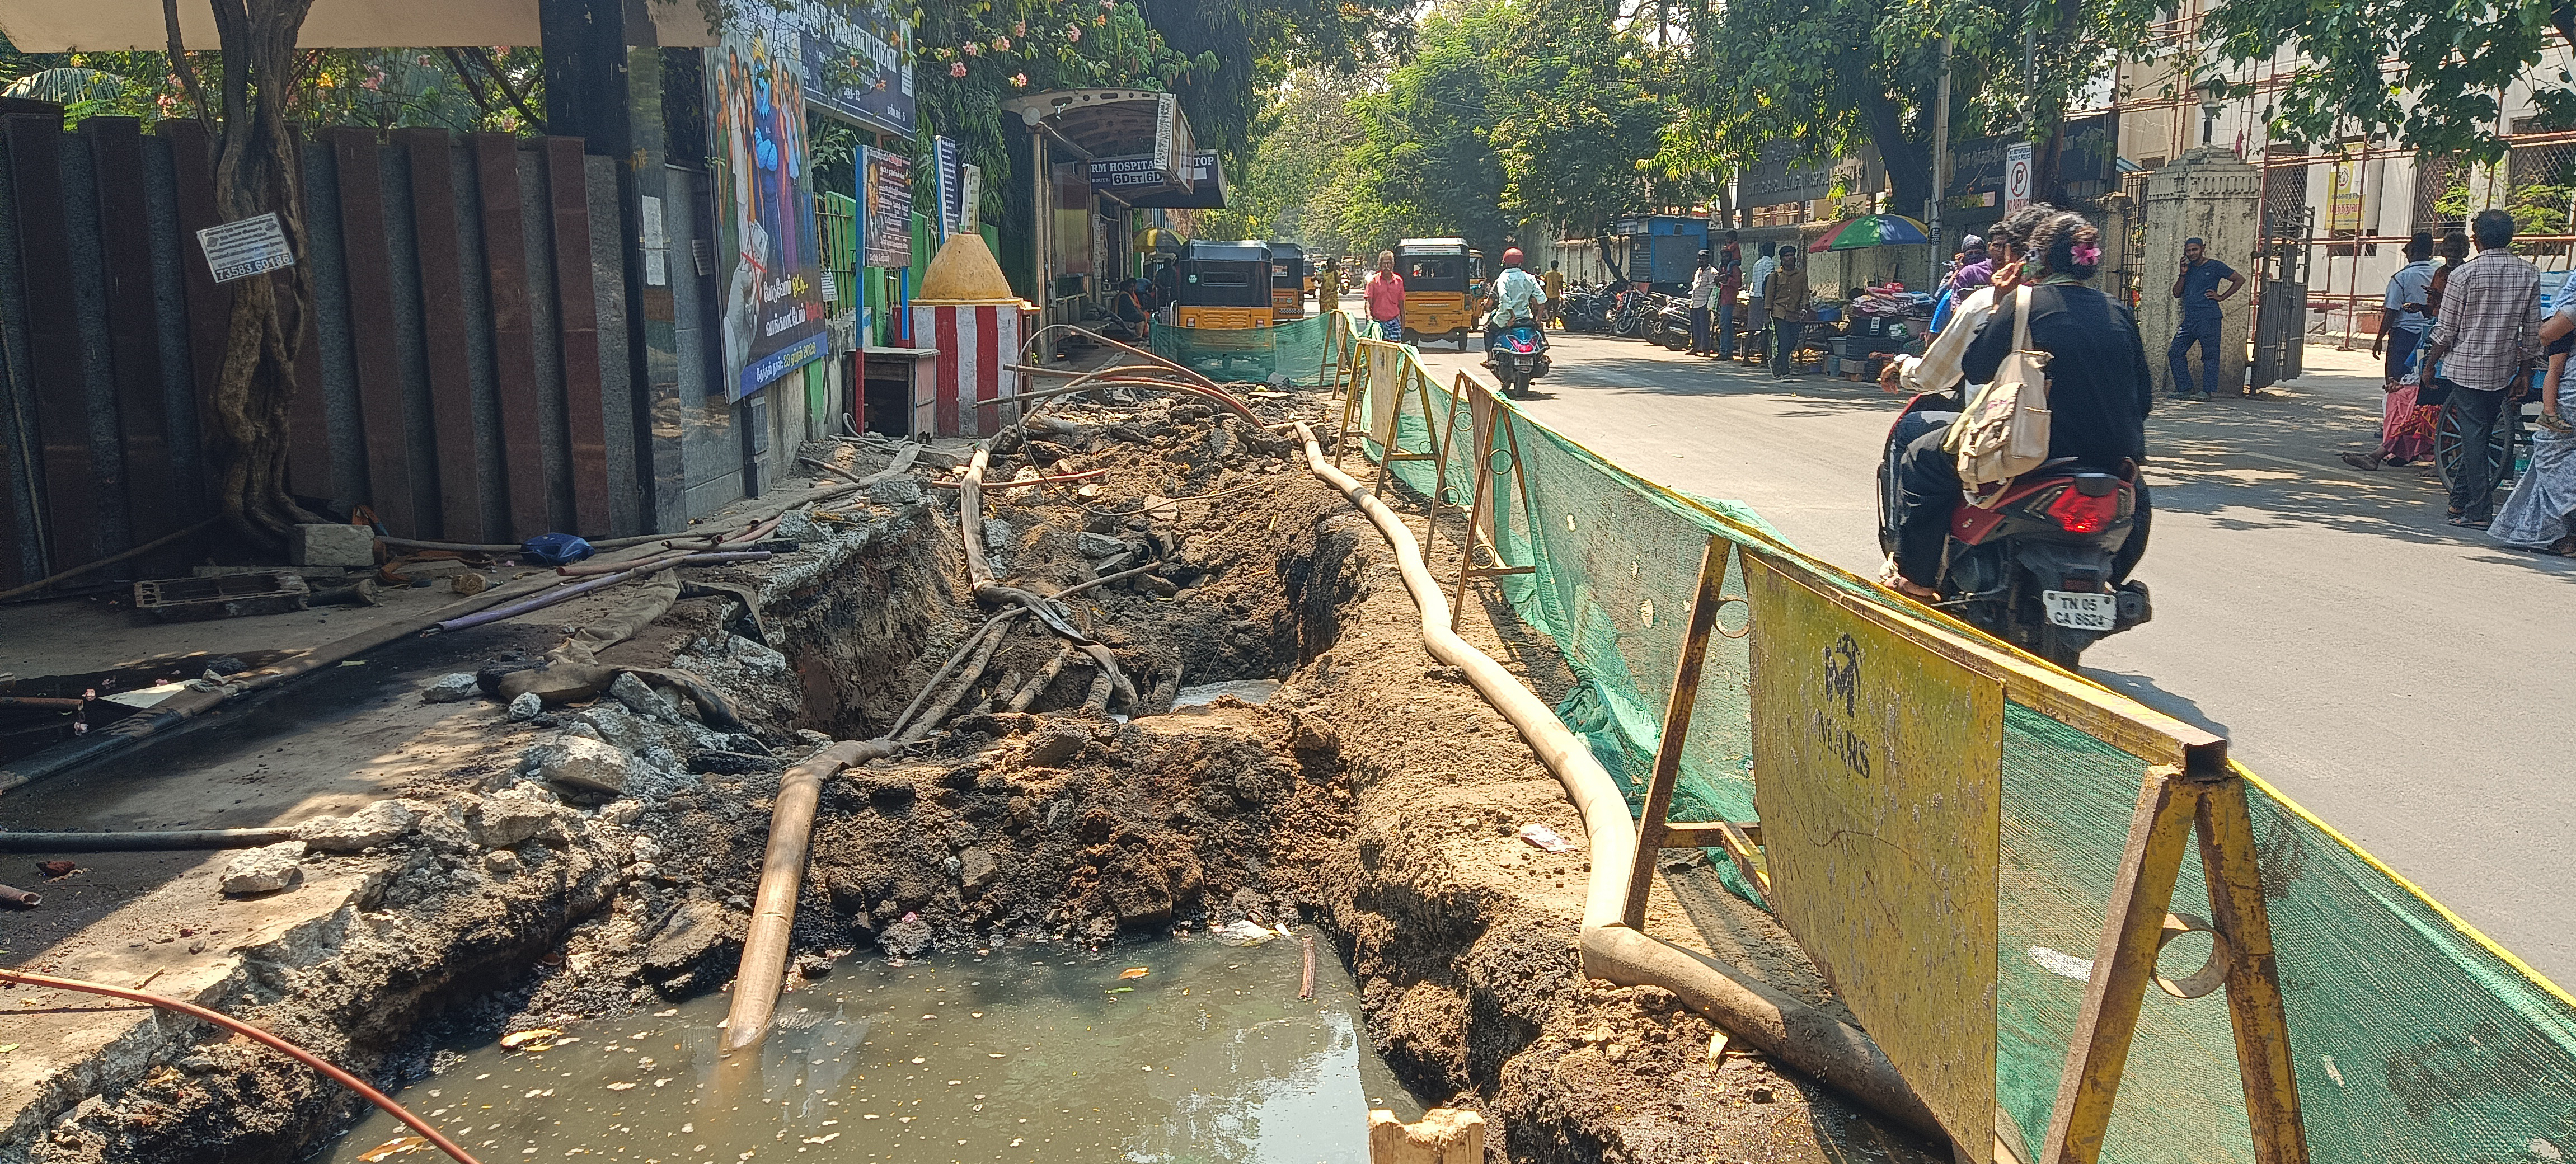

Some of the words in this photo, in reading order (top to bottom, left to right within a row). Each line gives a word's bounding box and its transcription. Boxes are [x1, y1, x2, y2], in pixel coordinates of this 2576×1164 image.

[217, 263, 252, 280] 73583
[255, 254, 290, 270] 60186
[763, 274, 791, 303] போடுவோம்
[766, 302, 806, 337] வாங்கமாட்டோம்
[783, 353, 790, 367] 23
[791, 346, 803, 368] ஏப்ரல்
[803, 342, 816, 358] 2026
[2061, 597, 2078, 610] TN
[2081, 598, 2098, 611] 05
[2054, 612, 2072, 625] CA
[1817, 708, 1870, 778] MARS
